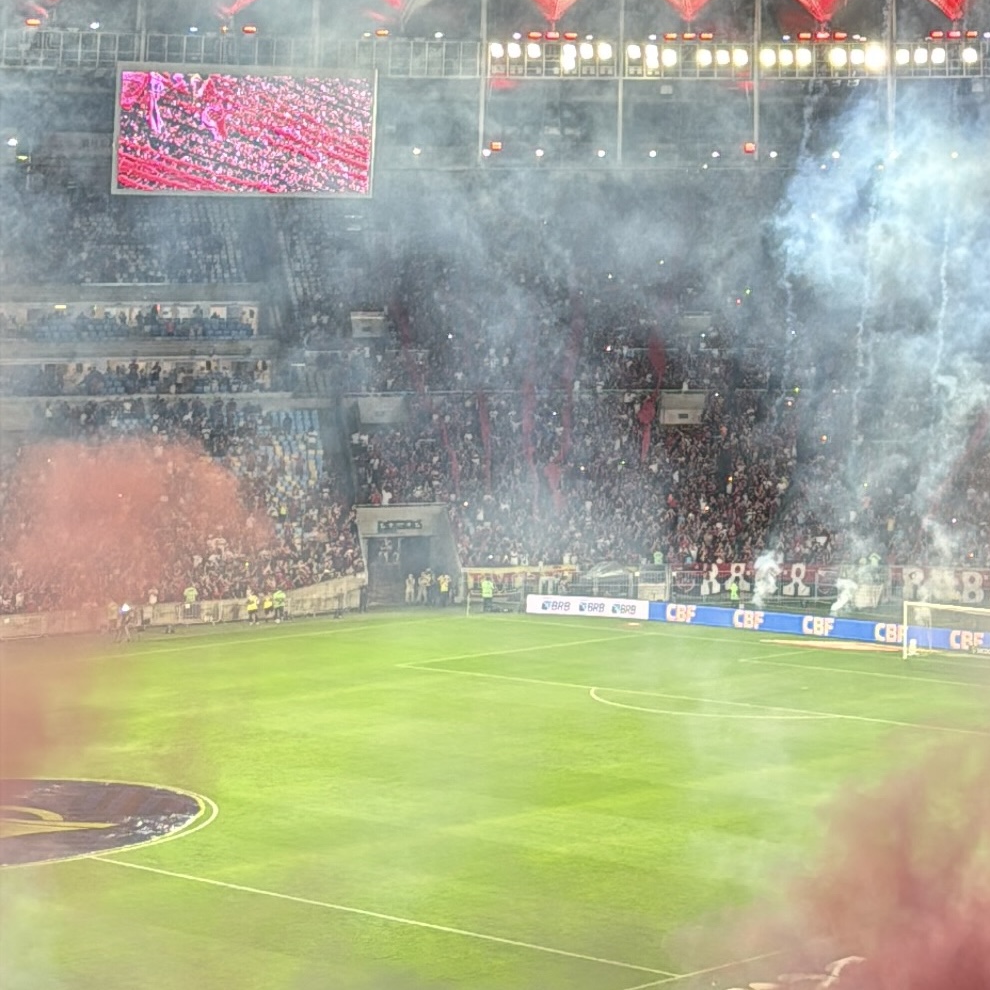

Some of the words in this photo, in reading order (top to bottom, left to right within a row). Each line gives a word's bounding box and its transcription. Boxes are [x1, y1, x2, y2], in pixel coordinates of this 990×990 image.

[666, 603, 697, 623] CBF
[733, 610, 765, 629] CBF
[802, 615, 835, 636] CBF
[950, 630, 984, 650] CBF
